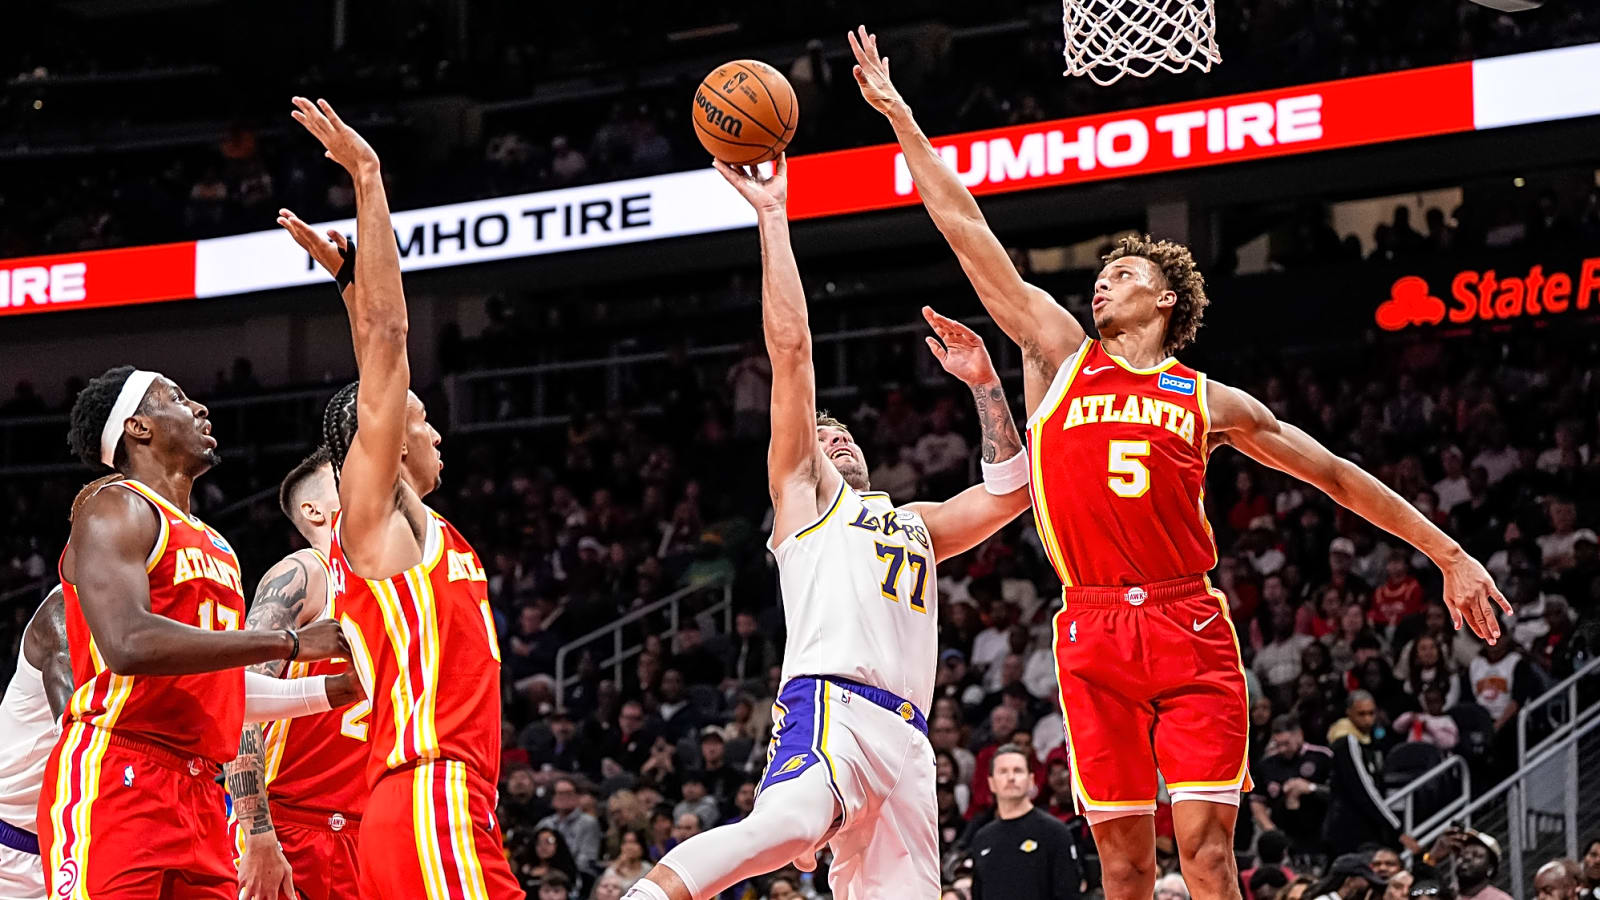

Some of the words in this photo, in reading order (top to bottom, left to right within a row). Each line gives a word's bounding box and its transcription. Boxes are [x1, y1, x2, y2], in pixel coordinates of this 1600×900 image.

[695, 88, 743, 138] Wilson
[1155, 94, 1324, 159] TIRE
[523, 193, 653, 241] TIRE
[1448, 264, 1572, 323] State
[1161, 377, 1192, 390] paze
[1063, 394, 1196, 448] ATLANTA
[1107, 440, 1151, 498] 5
[173, 546, 245, 600] ATLANT
[874, 540, 929, 615] 77
[197, 597, 240, 632] 17
